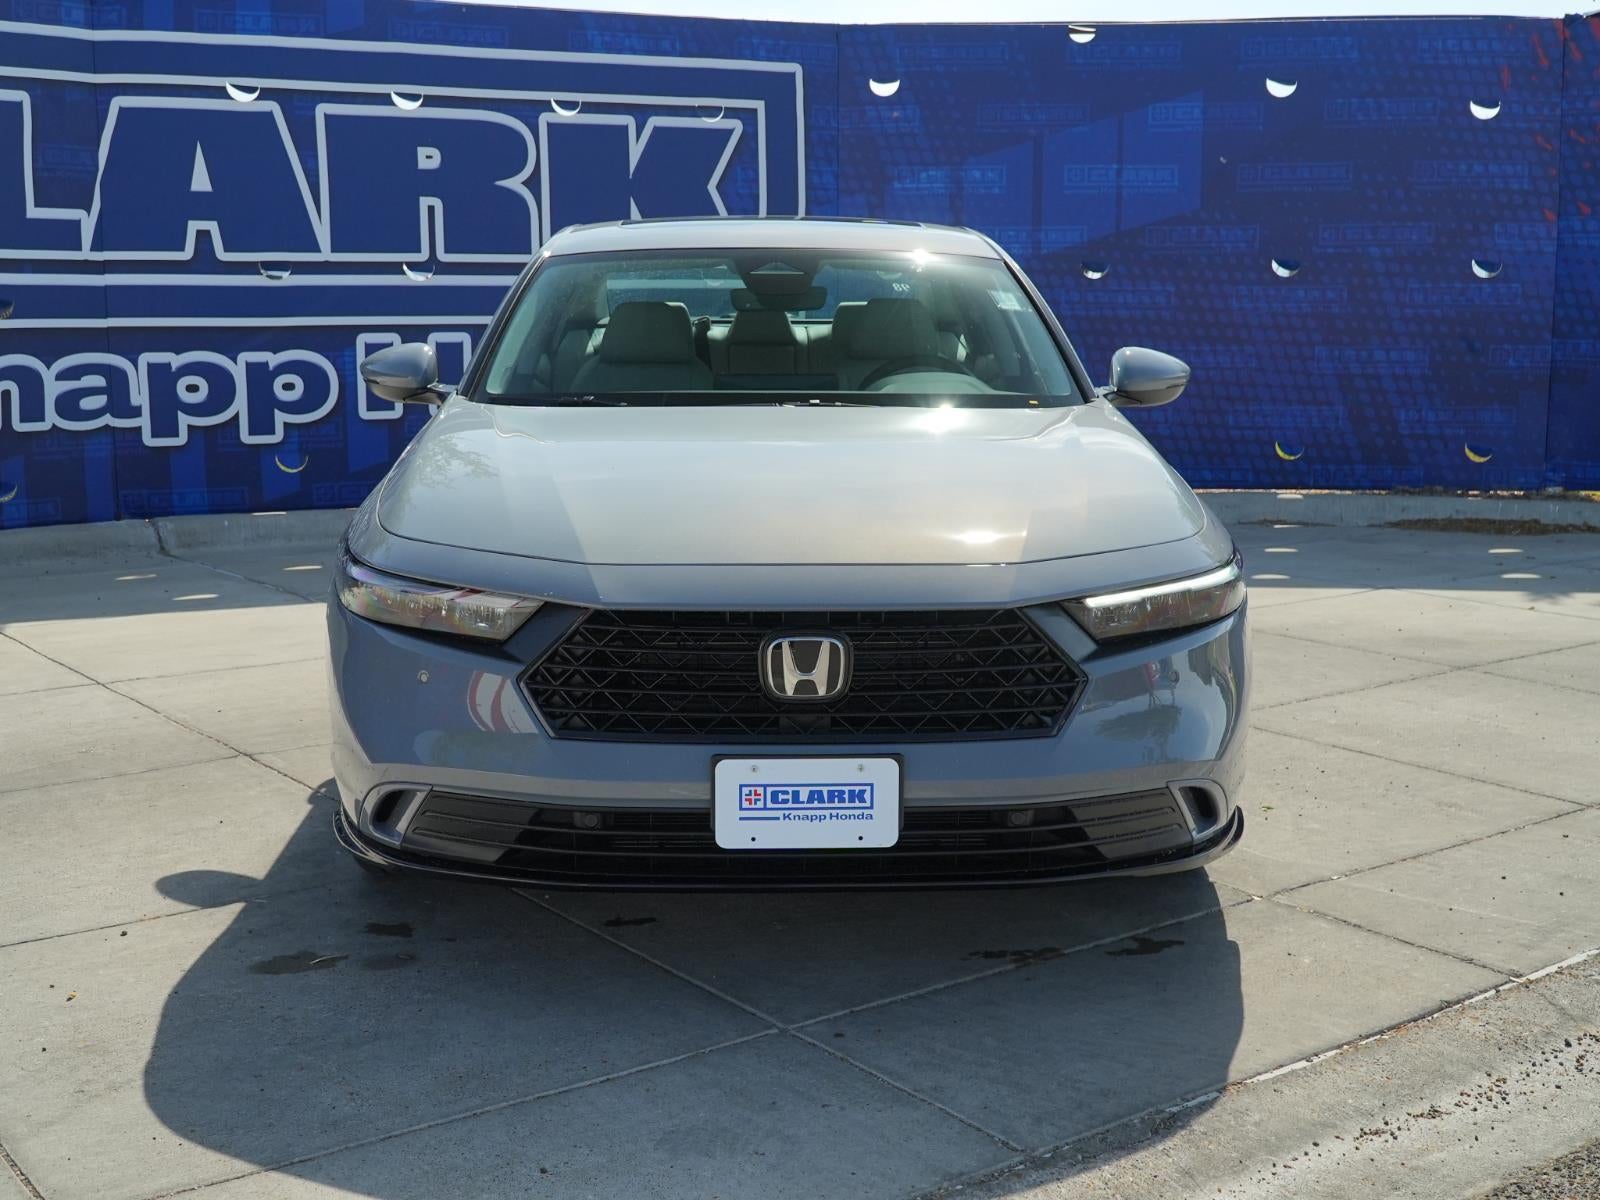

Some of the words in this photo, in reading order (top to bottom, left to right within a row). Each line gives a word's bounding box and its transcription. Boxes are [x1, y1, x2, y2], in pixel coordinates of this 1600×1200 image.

[770, 788, 867, 805] CLARK
[782, 812, 827, 823] Knapp
[829, 811, 874, 821] Honda
